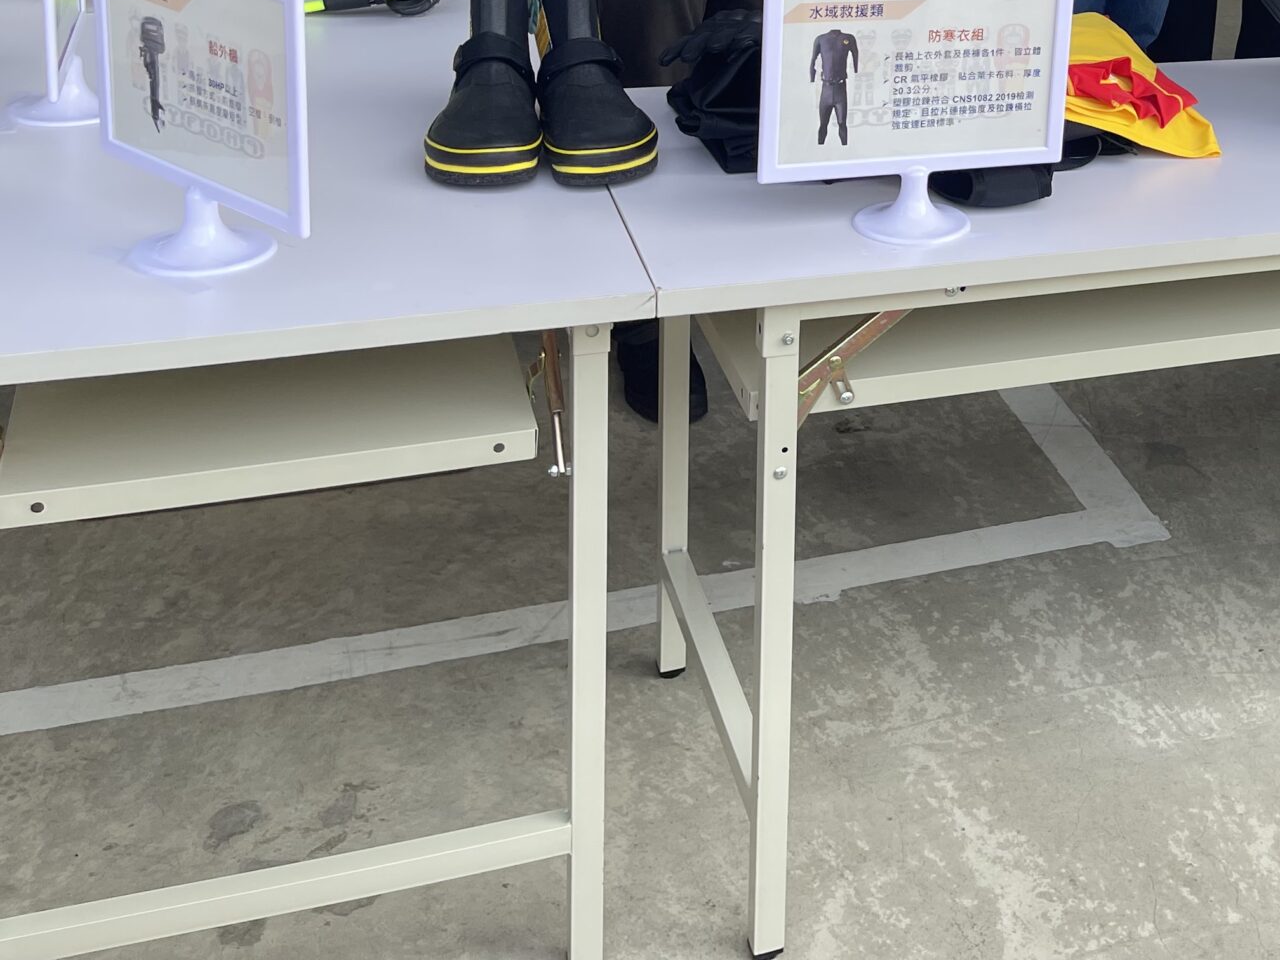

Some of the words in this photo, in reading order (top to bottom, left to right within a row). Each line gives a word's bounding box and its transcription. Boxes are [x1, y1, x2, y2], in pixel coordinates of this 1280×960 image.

[809, 3, 885, 20] 水域救援類
[928, 28, 985, 43] 防寒衣組
[893, 75, 908, 84] CR
